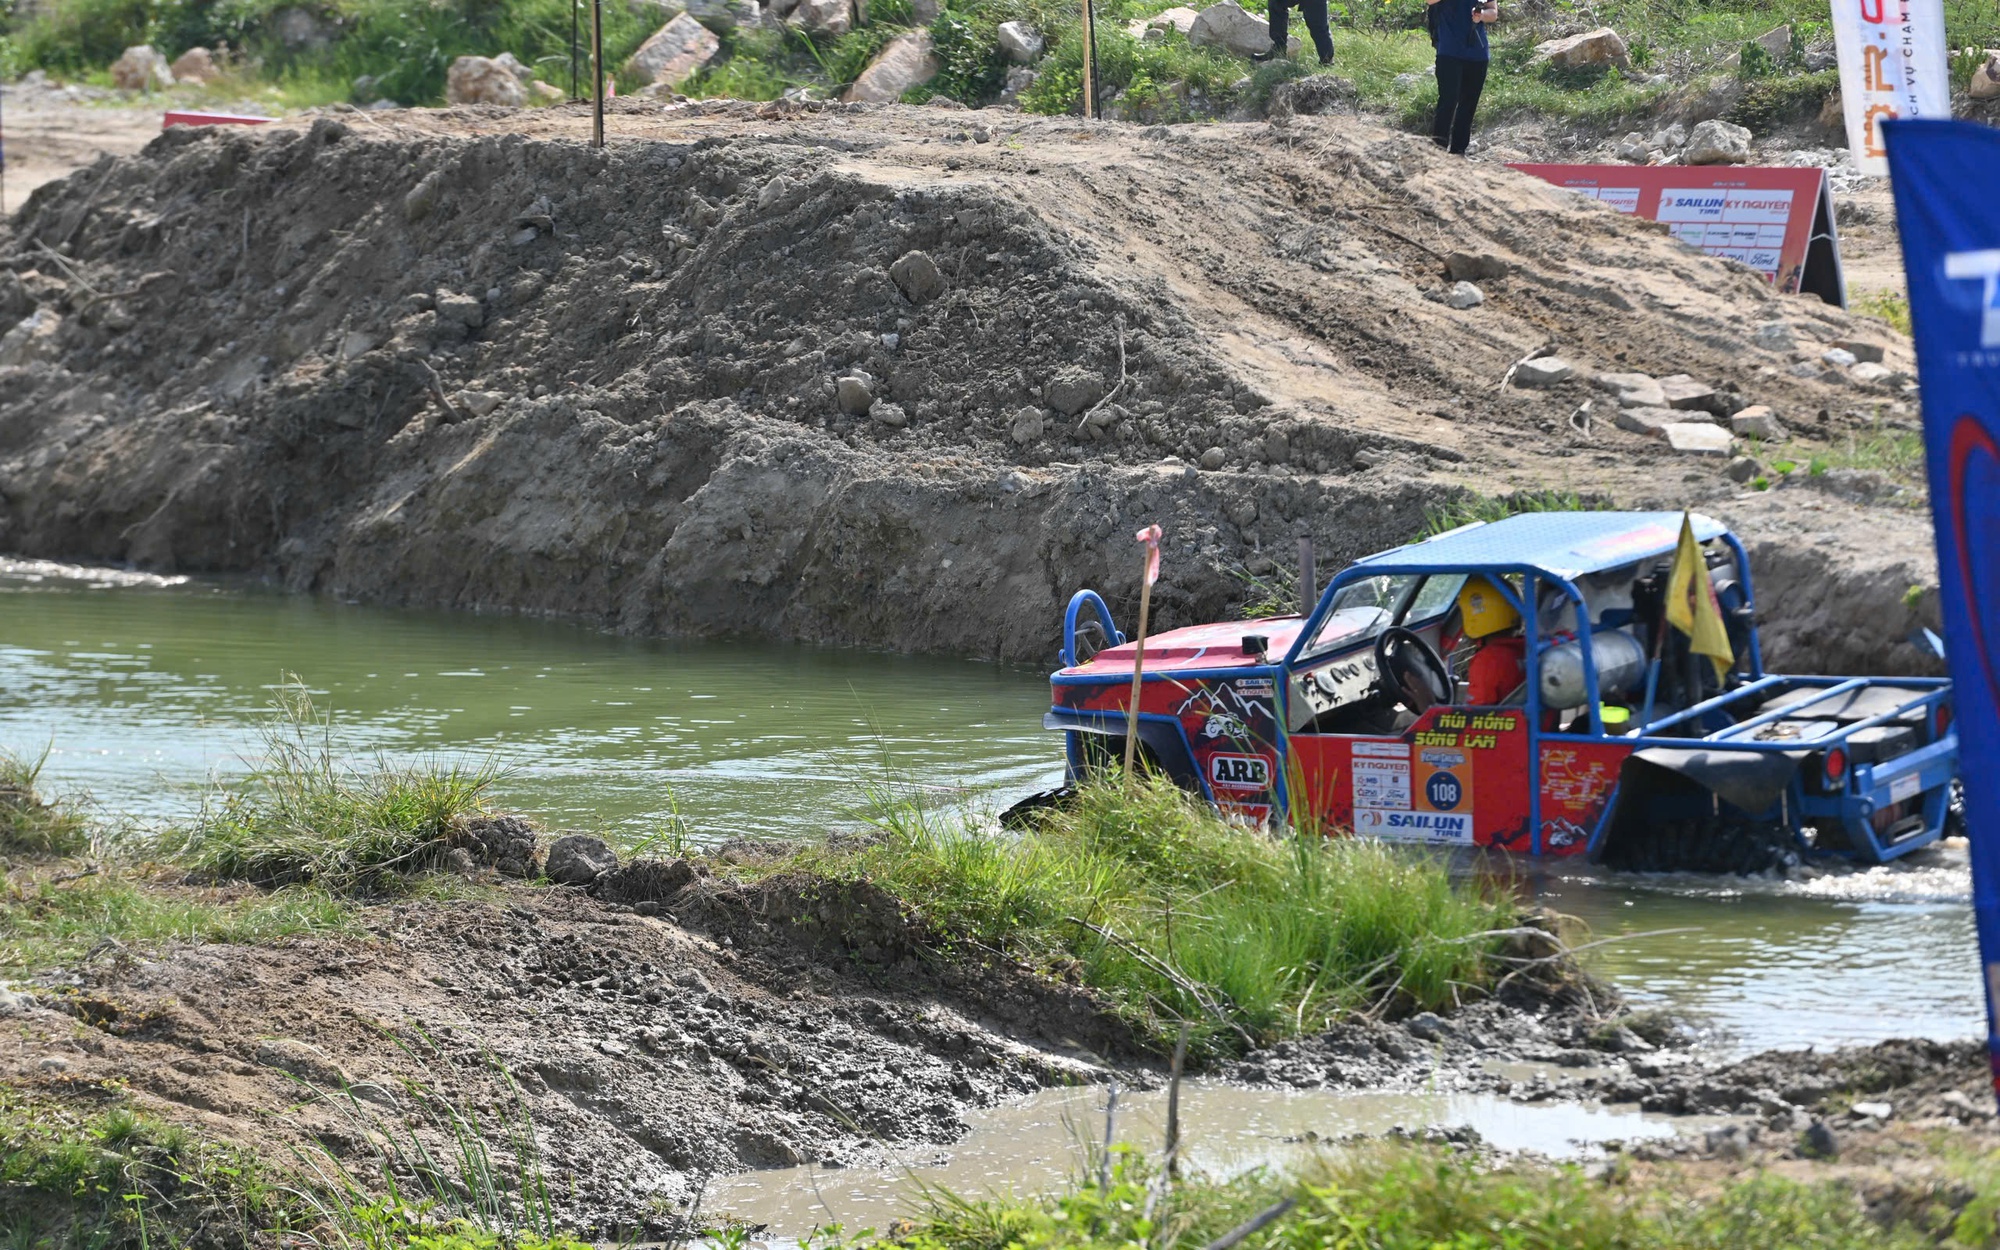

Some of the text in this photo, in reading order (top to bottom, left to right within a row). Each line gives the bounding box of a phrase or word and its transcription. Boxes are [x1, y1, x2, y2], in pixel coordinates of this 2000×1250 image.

[1902, 12, 1914, 57] CHẠM
[1905, 67, 1916, 86] VỤ
[1675, 198, 1725, 208] SAILUN
[1215, 759, 1267, 783] ARB
[1385, 789, 1406, 799] Ford
[1431, 783, 1457, 802] 108
[1387, 814, 1465, 830] SAILUN
[1434, 829, 1463, 838] TIRE
